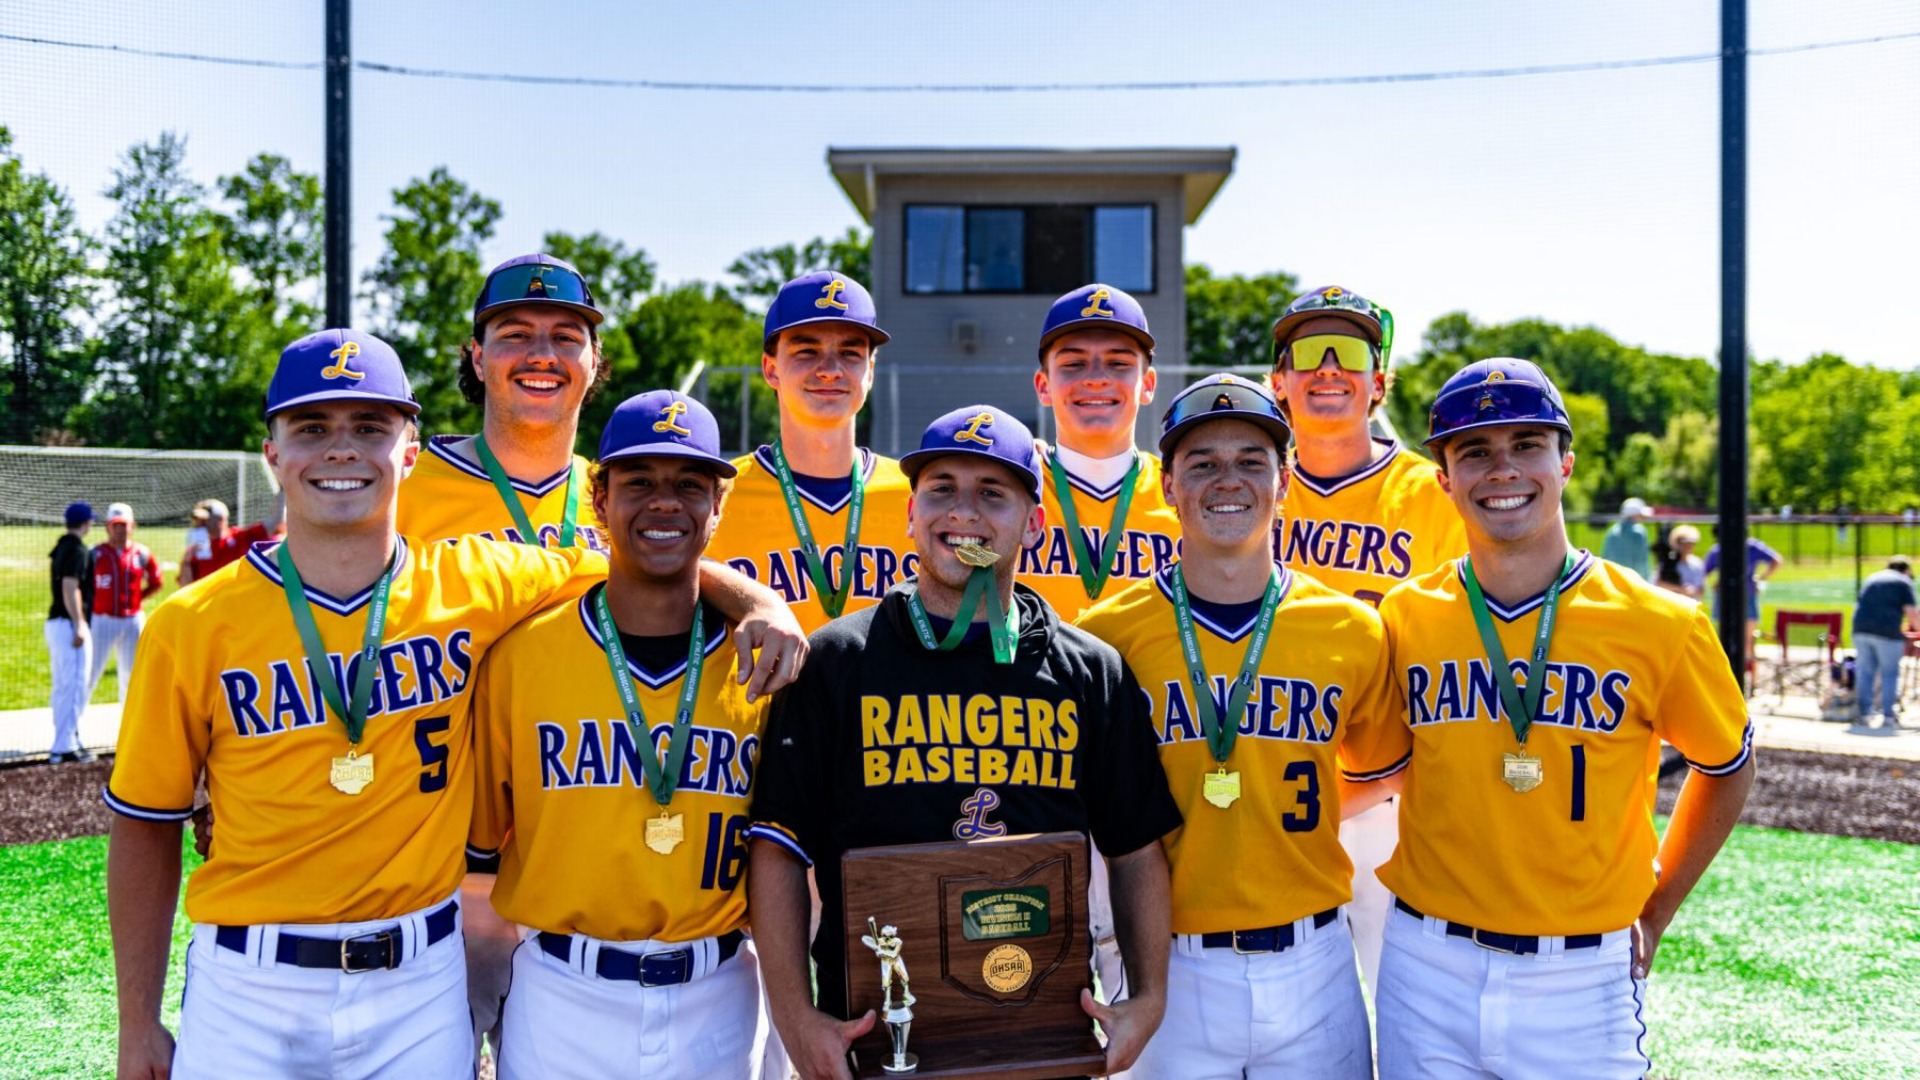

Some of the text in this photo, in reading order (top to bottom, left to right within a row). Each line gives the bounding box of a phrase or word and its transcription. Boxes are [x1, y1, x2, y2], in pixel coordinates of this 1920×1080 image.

[1017, 526, 1183, 579] RANGER
[1273, 519, 1413, 579] NGERS
[861, 694, 1079, 751] RANGERS
[415, 715, 450, 793] 5
[863, 747, 1076, 790] BASEBALL
[1570, 744, 1585, 821] 1
[953, 787, 1007, 840] L
[1282, 761, 1320, 832] 3
[700, 812, 749, 891] 16
[981, 921, 1031, 935] BASEBALL
[992, 960, 1023, 975] OHSAA
